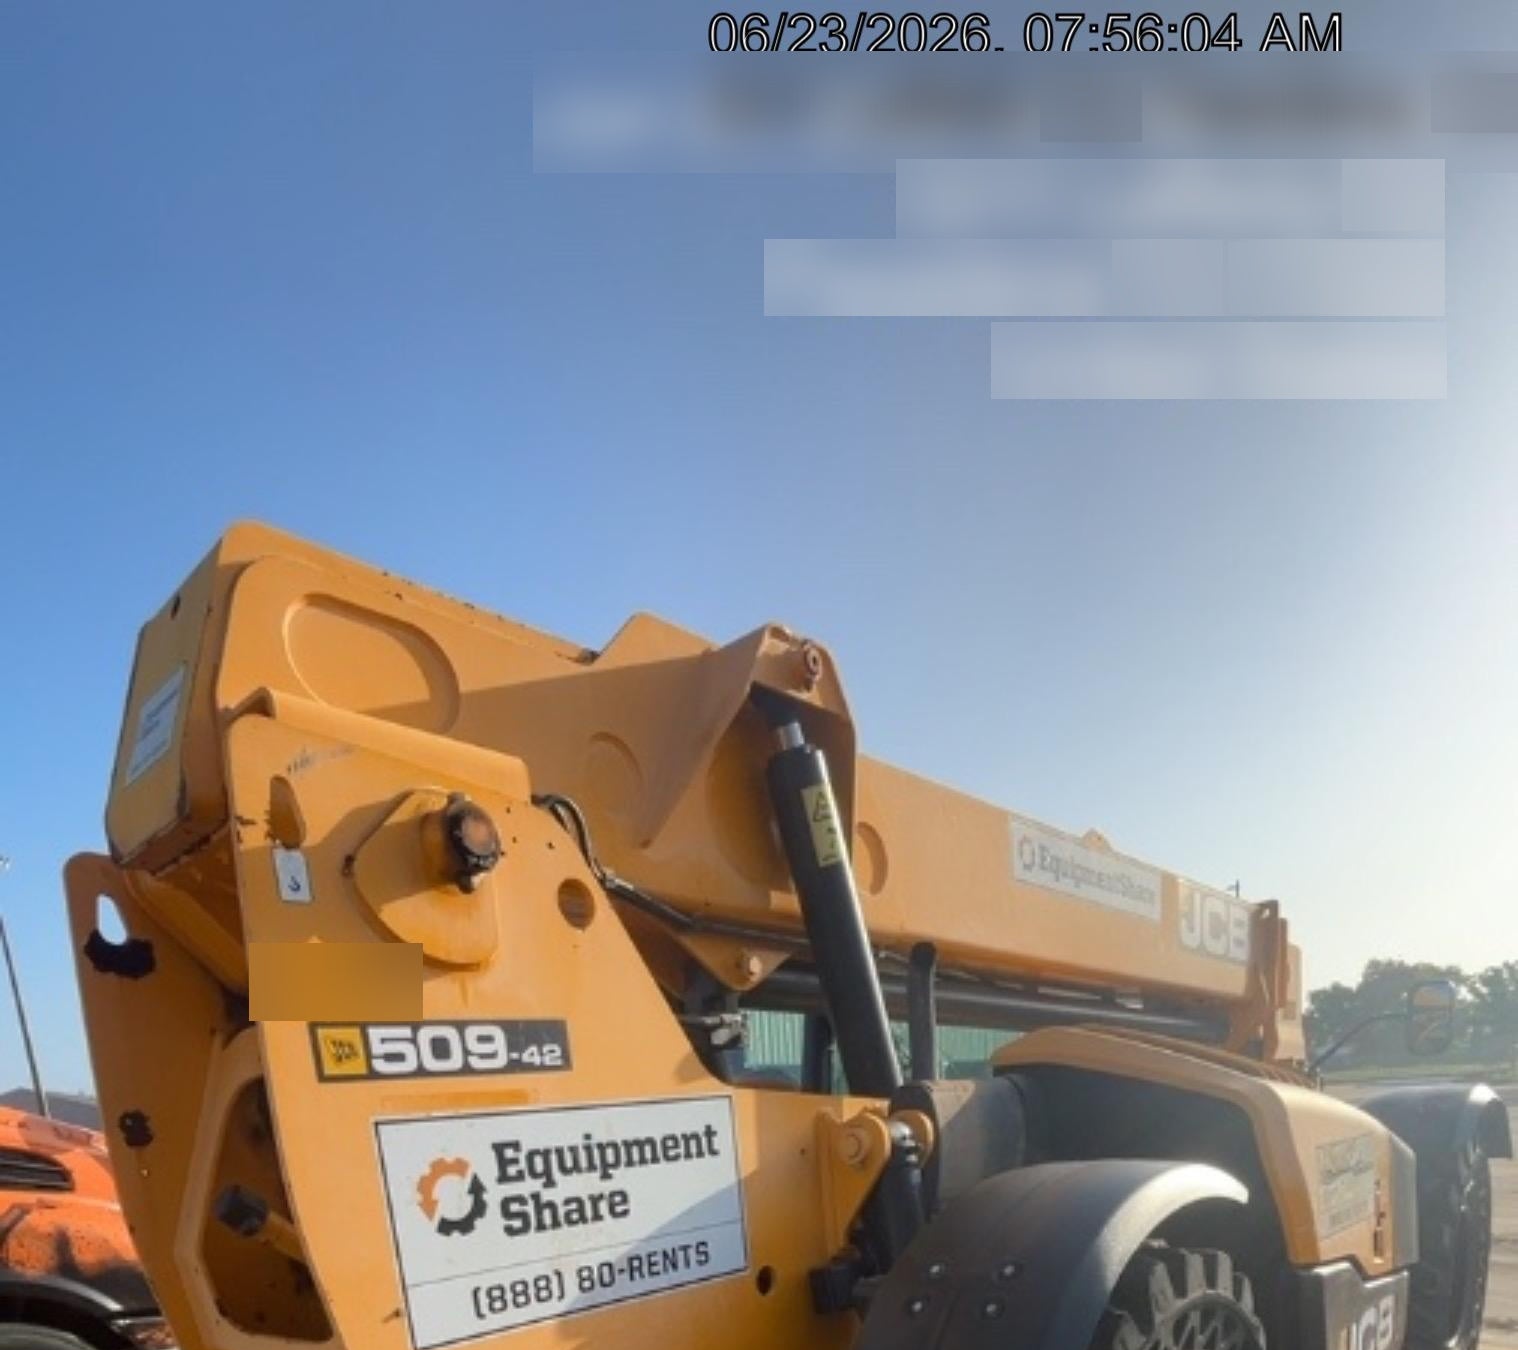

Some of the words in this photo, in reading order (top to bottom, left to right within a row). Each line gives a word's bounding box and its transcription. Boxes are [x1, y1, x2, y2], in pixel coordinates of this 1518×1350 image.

[1180, 888, 1249, 961] JCB
[491, 1123, 721, 1189] Equipment
[500, 1188, 631, 1238] Share
[472, 1270, 566, 1319] (888)
[577, 1241, 711, 1293] 80-RENTS
